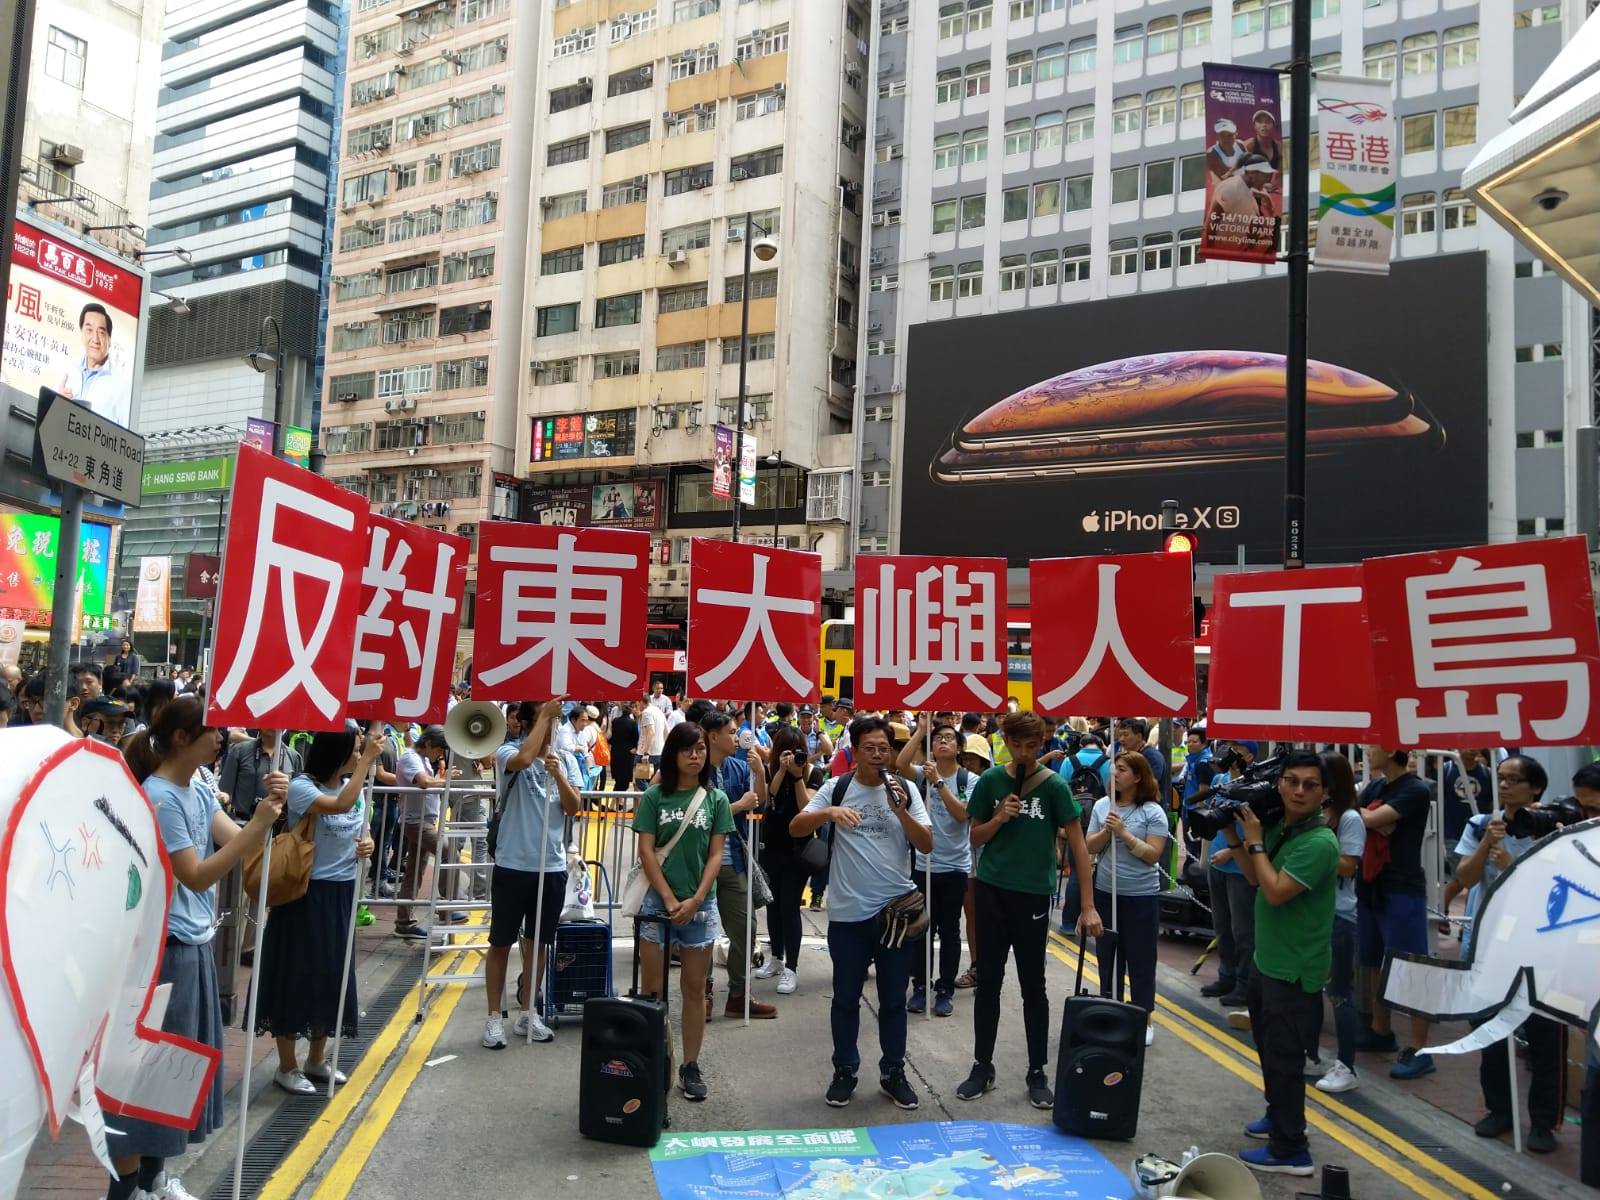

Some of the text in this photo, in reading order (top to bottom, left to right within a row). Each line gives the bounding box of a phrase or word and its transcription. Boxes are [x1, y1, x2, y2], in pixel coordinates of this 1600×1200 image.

[1326, 131, 1390, 165] 香港
[1209, 223, 1274, 236] VICTORIA PARK
[1210, 212, 1276, 226] 6-14/10/2018
[1208, 234, 1273, 246] www.cityline.com
[7, 283, 42, 322] 風
[67, 412, 142, 463] East Point Road
[84, 455, 124, 492] 東角道
[153, 469, 220, 485] HANG SENG BANK
[216, 477, 1590, 744] 反 對 東 大 嶼 人 工 島
